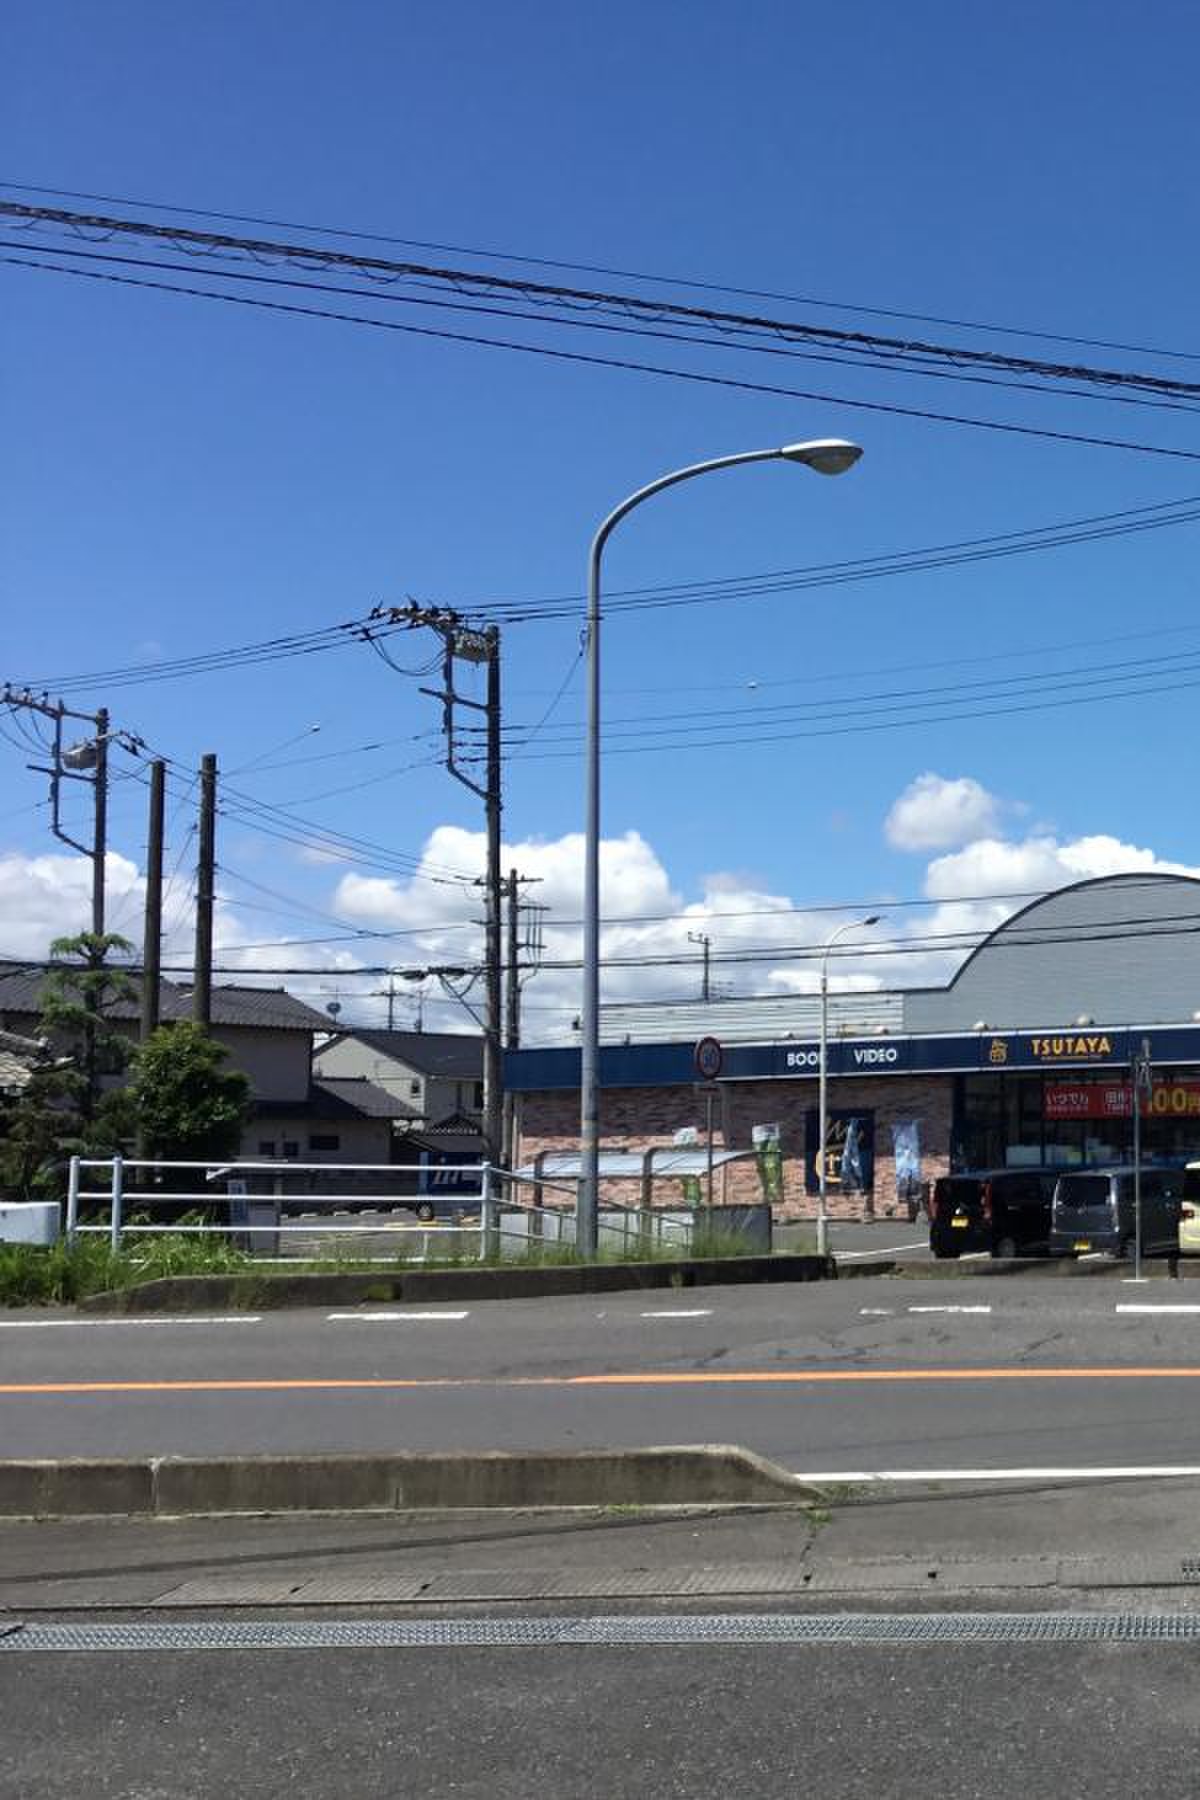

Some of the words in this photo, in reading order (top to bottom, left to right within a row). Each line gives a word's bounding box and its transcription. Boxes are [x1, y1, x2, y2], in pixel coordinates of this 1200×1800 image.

[1030, 1036, 1111, 1056] TSUTAYA
[786, 1051, 829, 1067] BOO
[853, 1047, 898, 1064] VIDEO
